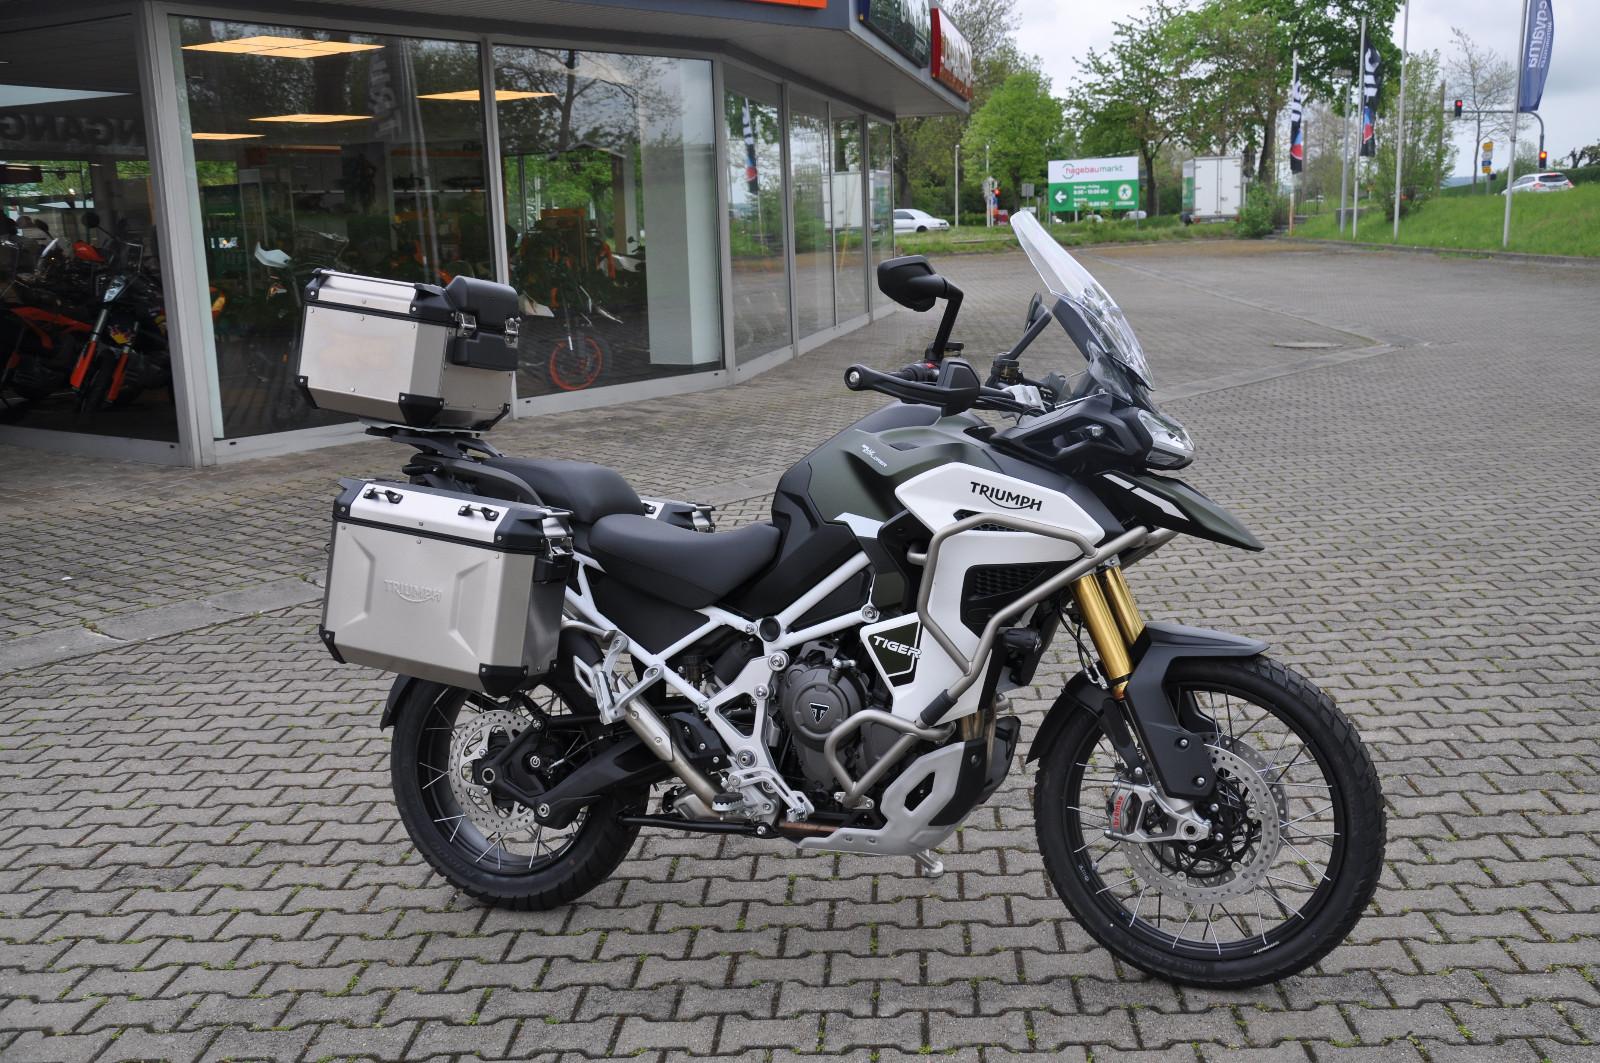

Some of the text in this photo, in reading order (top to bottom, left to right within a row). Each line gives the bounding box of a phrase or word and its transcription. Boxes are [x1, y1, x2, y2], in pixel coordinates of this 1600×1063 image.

[1066, 165, 1123, 175] hagebaumarkt
[970, 481, 1042, 511] TRIUMPH
[384, 579, 442, 602] TRIUMPH
[873, 635, 922, 659] TIGER
[1113, 795, 1124, 831] brembo
